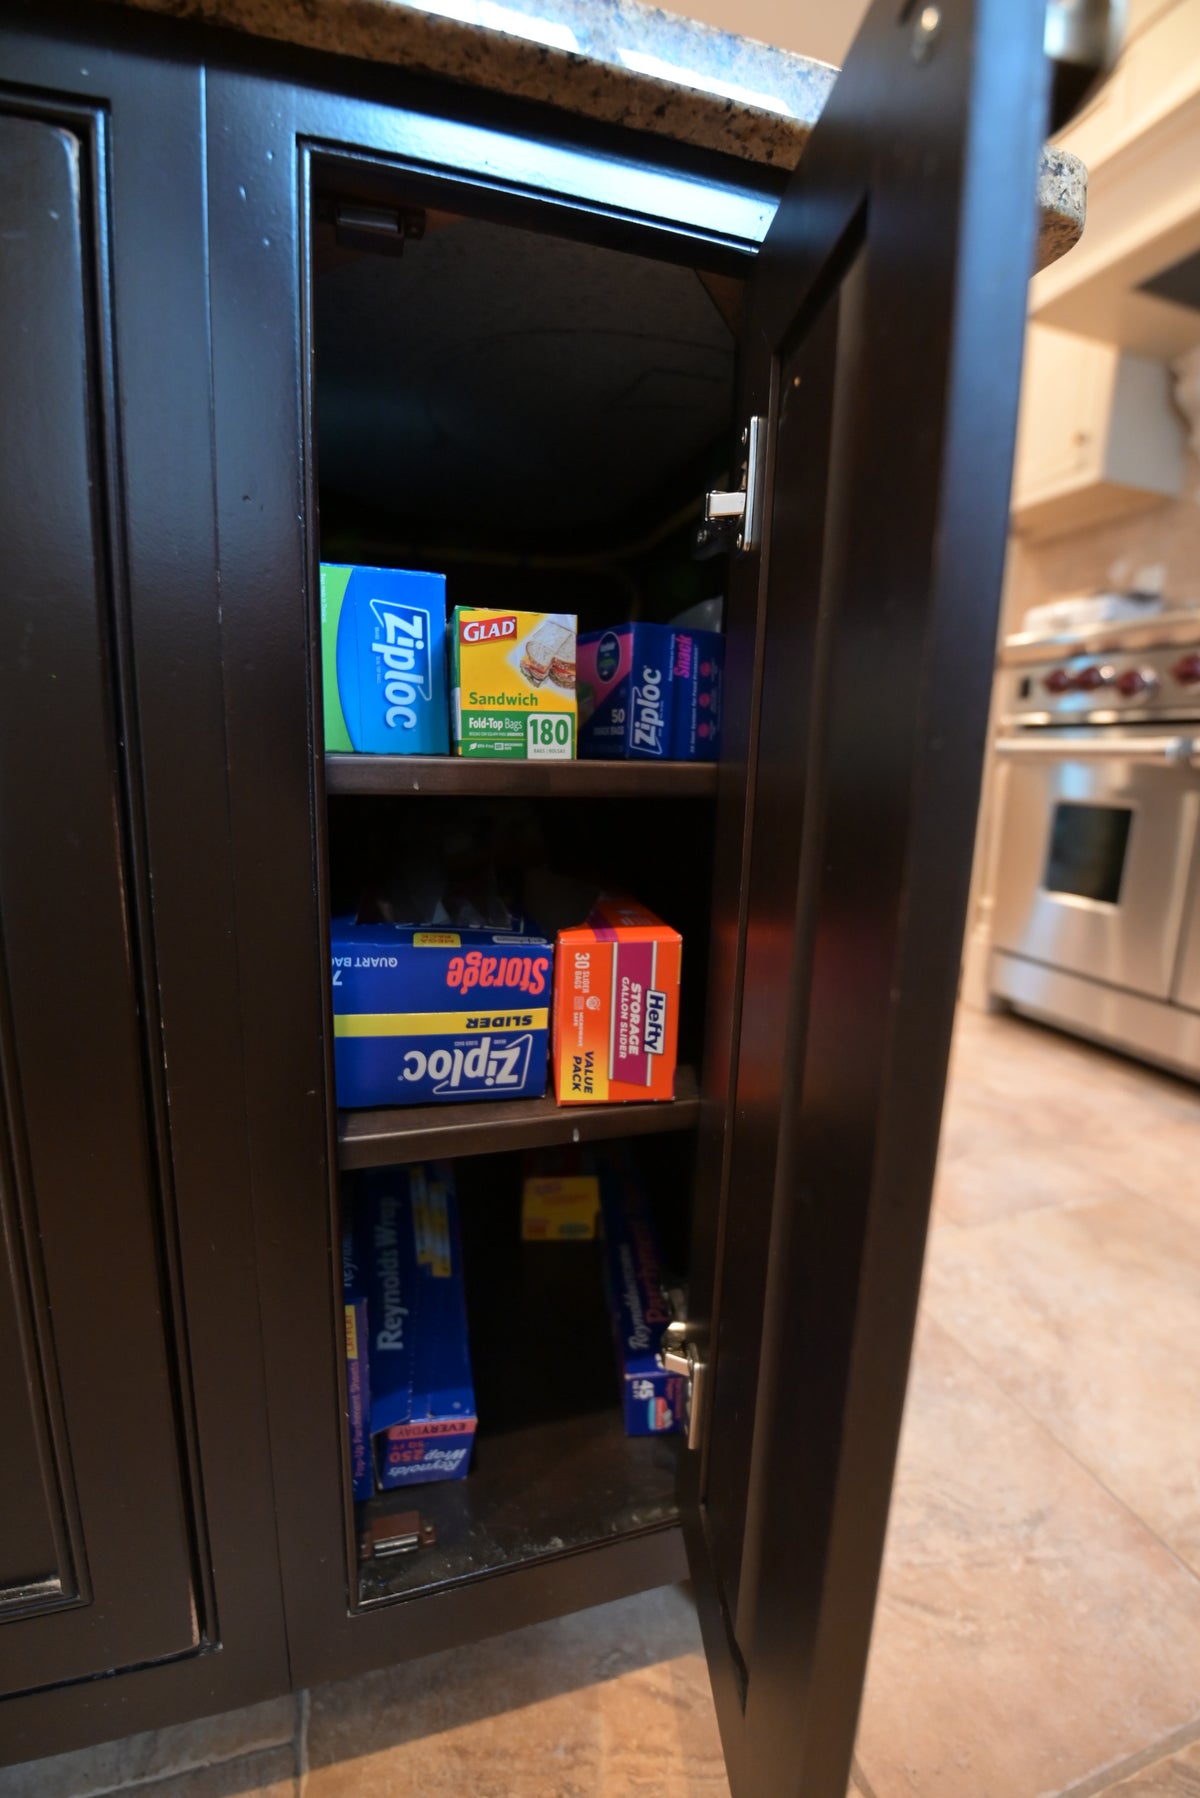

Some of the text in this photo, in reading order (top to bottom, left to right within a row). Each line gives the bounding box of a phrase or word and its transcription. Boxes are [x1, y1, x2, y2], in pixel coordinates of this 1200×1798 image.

[463, 622, 515, 642] GLAD
[674, 634, 692, 679] Snack
[372, 612, 424, 729] Ziploc
[469, 692, 538, 706] Sandwich
[634, 668, 665, 747] Ziploc
[469, 717, 523, 732] Fold-Top Bags
[611, 709, 625, 723] 50
[530, 719, 569, 745] 180
[354, 957, 398, 968] QUART
[575, 952, 590, 969] 30
[446, 951, 549, 995] Storage
[574, 971, 582, 990] BAGS
[582, 971, 590, 994] SLIDER
[465, 1015, 533, 1028] SLIDER
[619, 976, 630, 1059] GALLON SLIDER
[628, 982, 642, 1056] STORAGE
[644, 994, 664, 1051] Hefty
[403, 1037, 521, 1087] Ziploc
[584, 1051, 595, 1094] VALUE
[572, 1055, 582, 1092] PACK
[374, 1195, 409, 1351] Reynolds Wrap
[639, 1380, 654, 1400] 45
[398, 1422, 466, 1437] EVERYDAY
[389, 1449, 425, 1464] 250
[423, 1448, 467, 1461] Wrap
[387, 1459, 462, 1477] Reynolds
